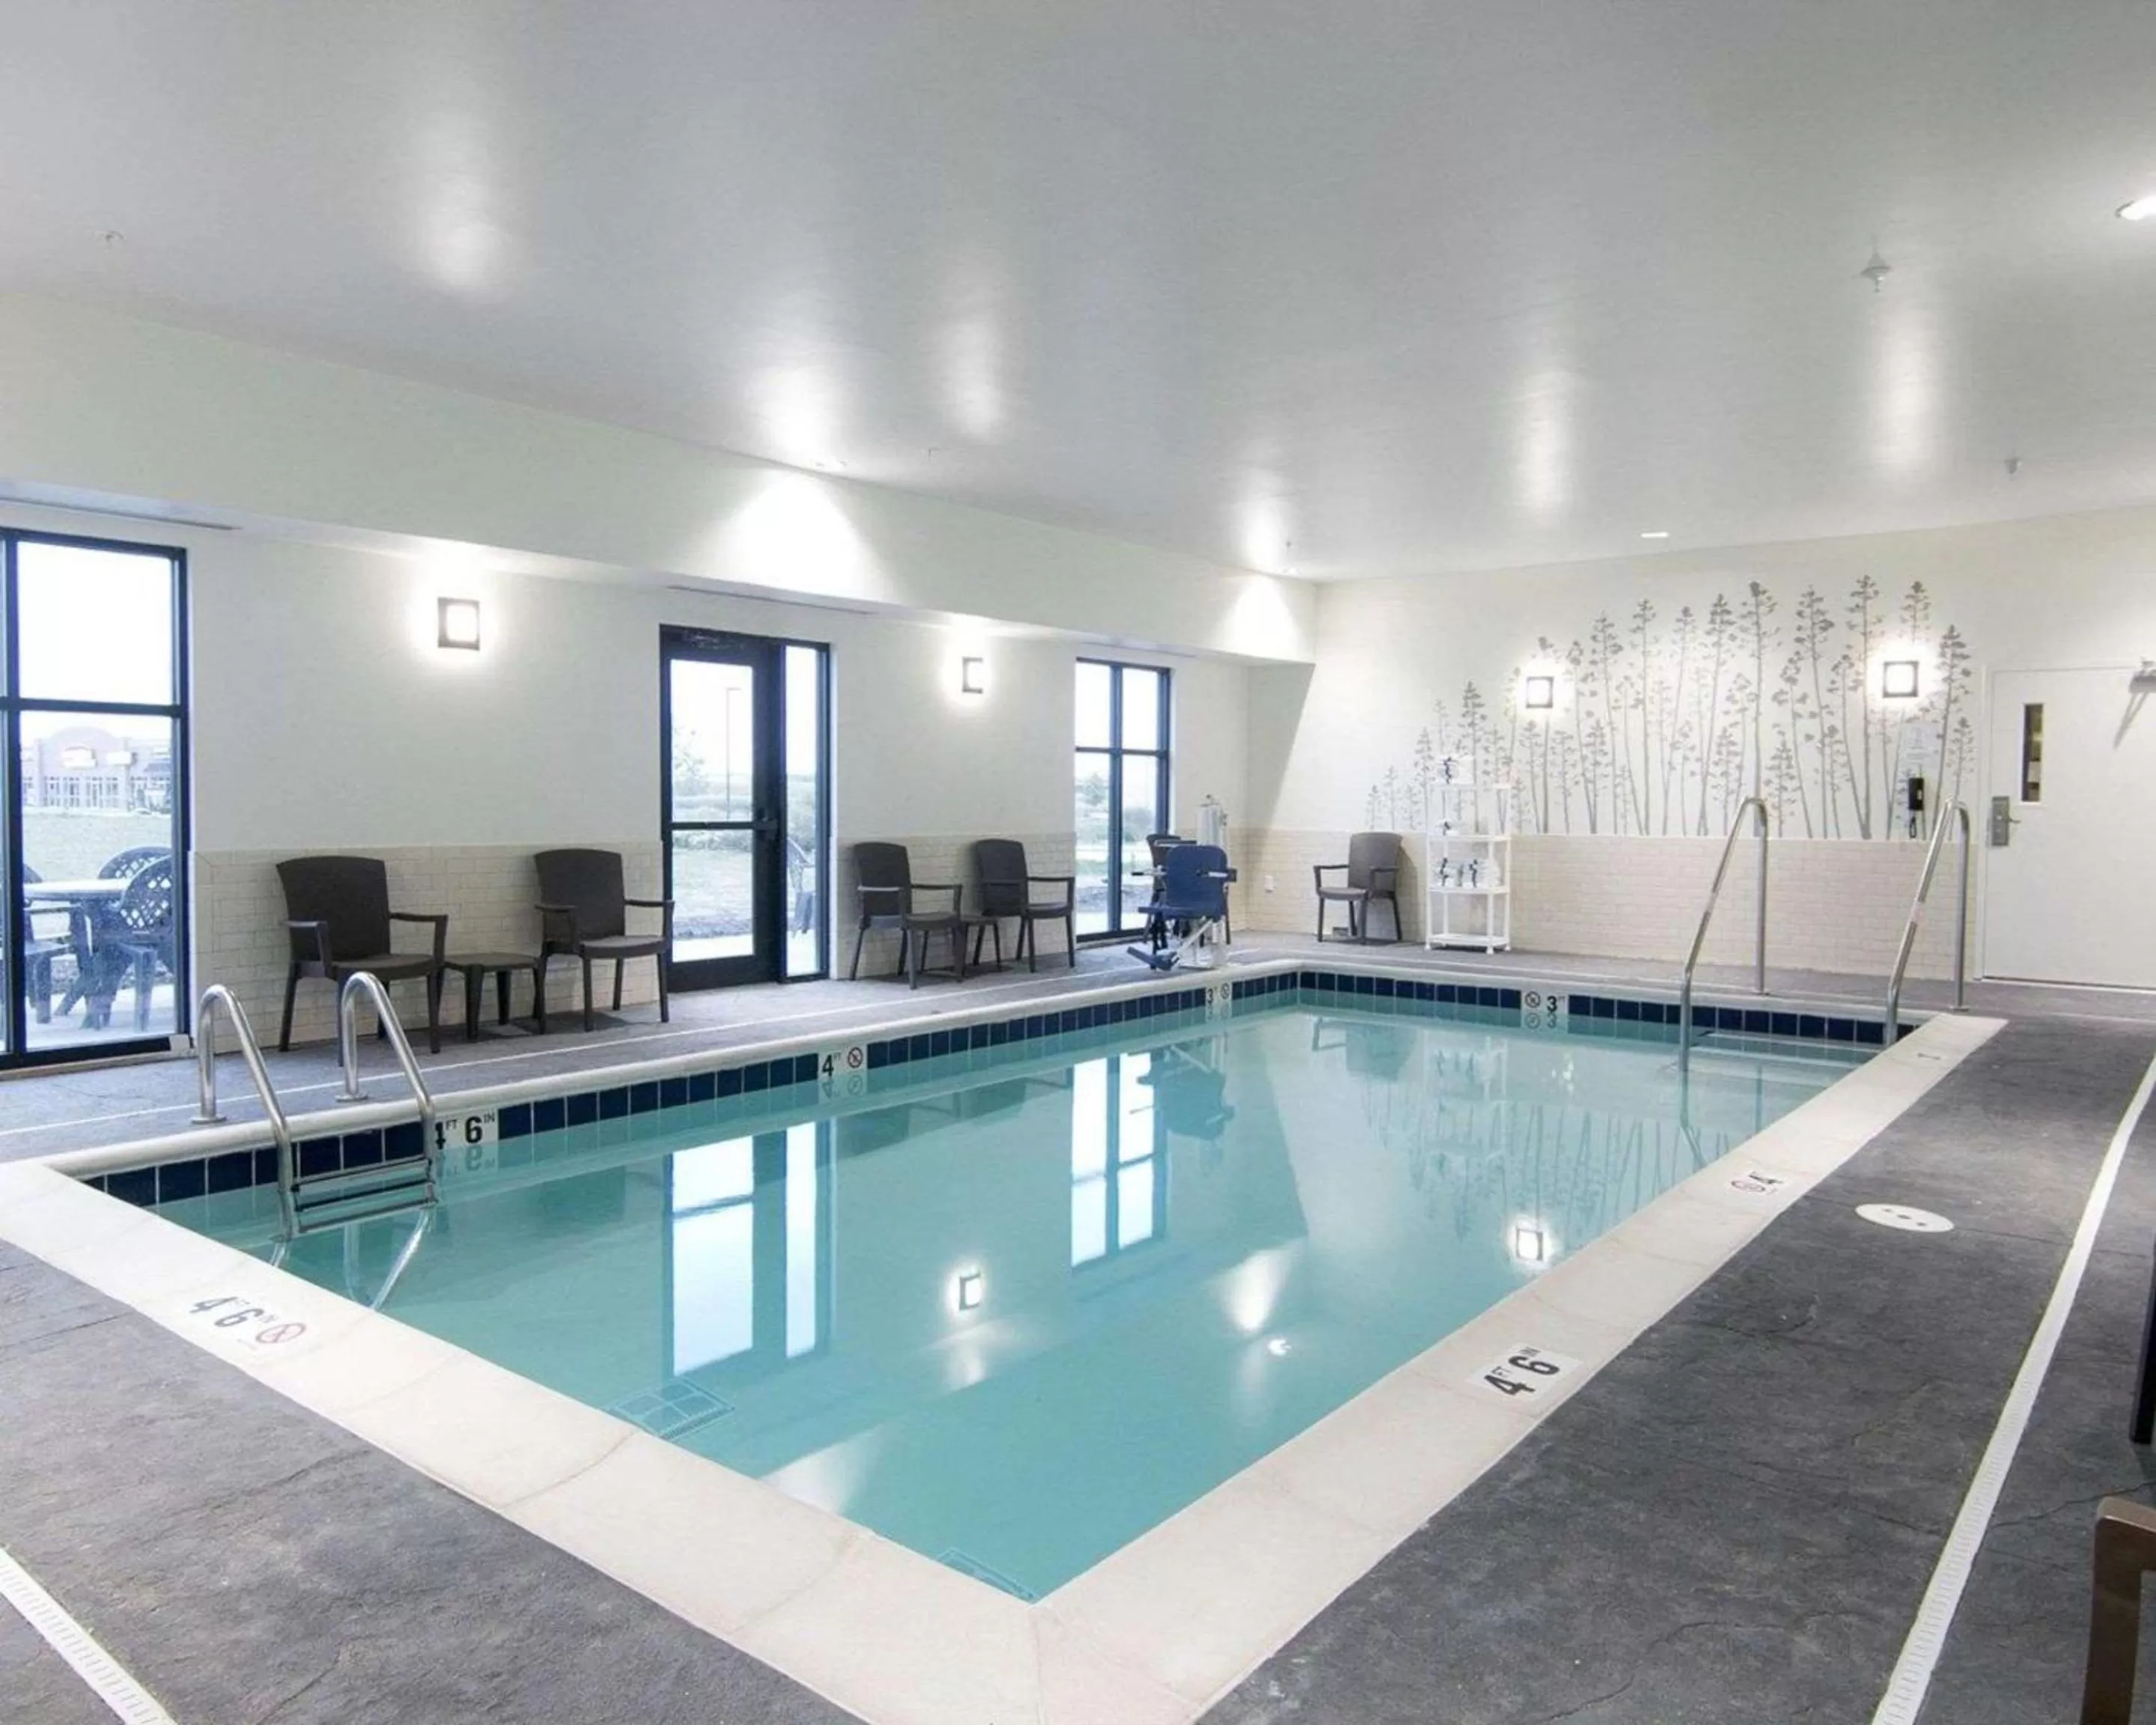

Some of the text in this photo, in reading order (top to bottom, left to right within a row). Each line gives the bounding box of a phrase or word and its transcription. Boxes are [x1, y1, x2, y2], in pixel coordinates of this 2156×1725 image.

[1547, 996, 1557, 1012] 3
[822, 1054, 834, 1077] 4
[465, 1116, 483, 1144] 6
[1507, 1355, 1560, 1375] 6
[1483, 1375, 1536, 1396] 4
